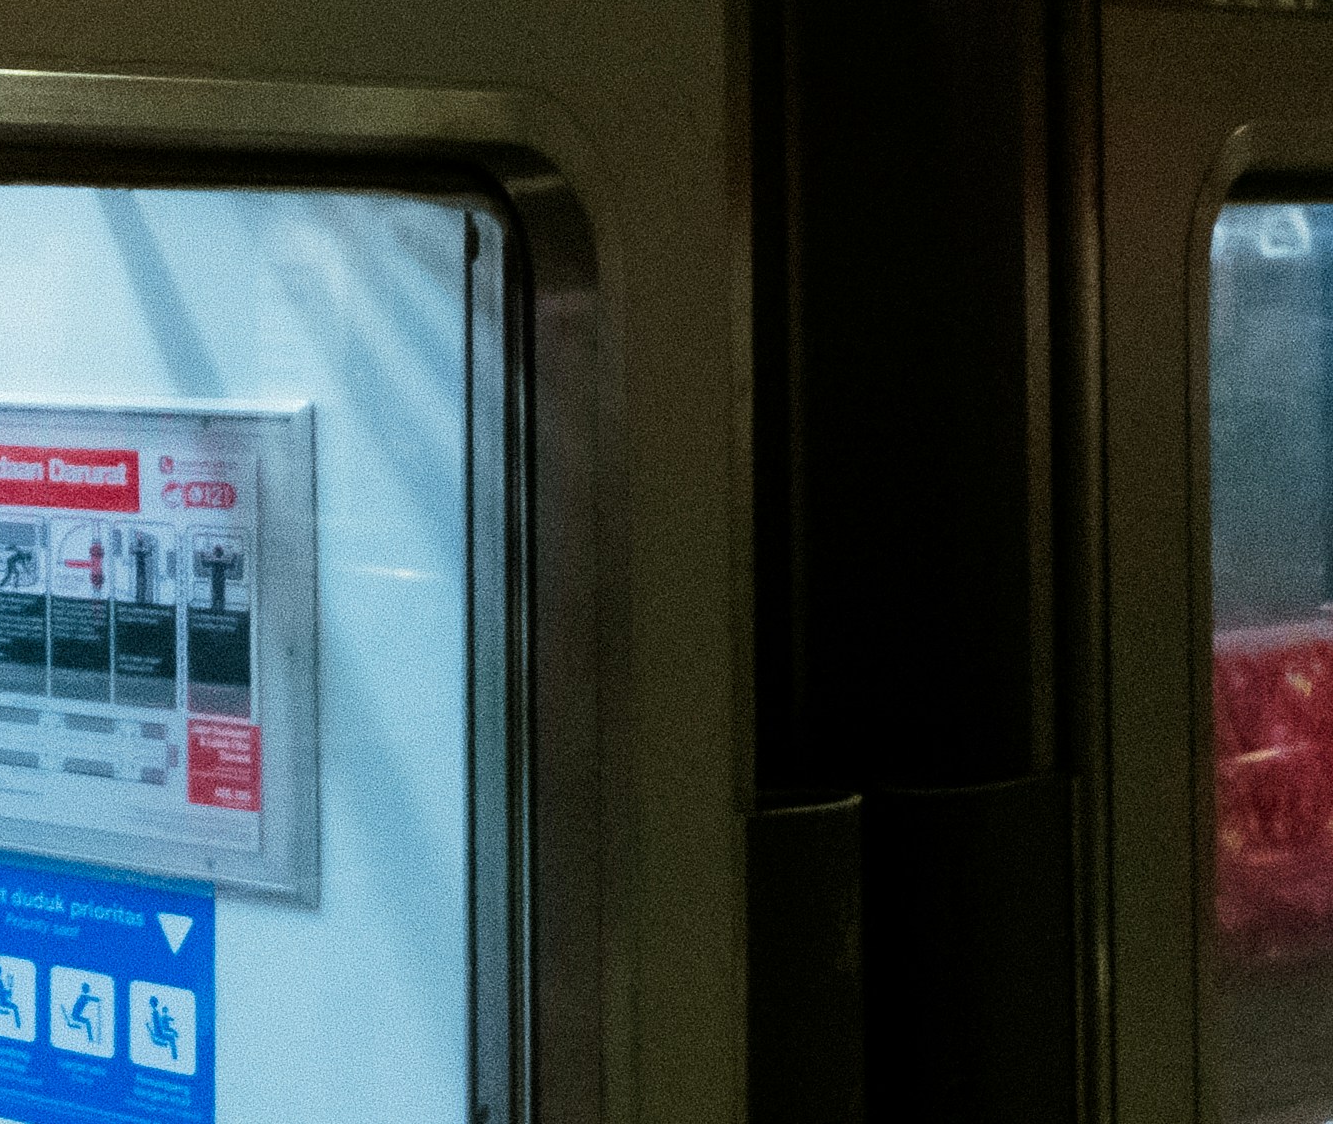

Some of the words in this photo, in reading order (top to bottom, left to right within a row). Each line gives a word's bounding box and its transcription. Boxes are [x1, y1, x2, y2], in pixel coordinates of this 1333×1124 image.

[49, 458, 128, 485] Darurat
[12, 887, 66, 914] duduk
[70, 901, 145, 928] prioritas
